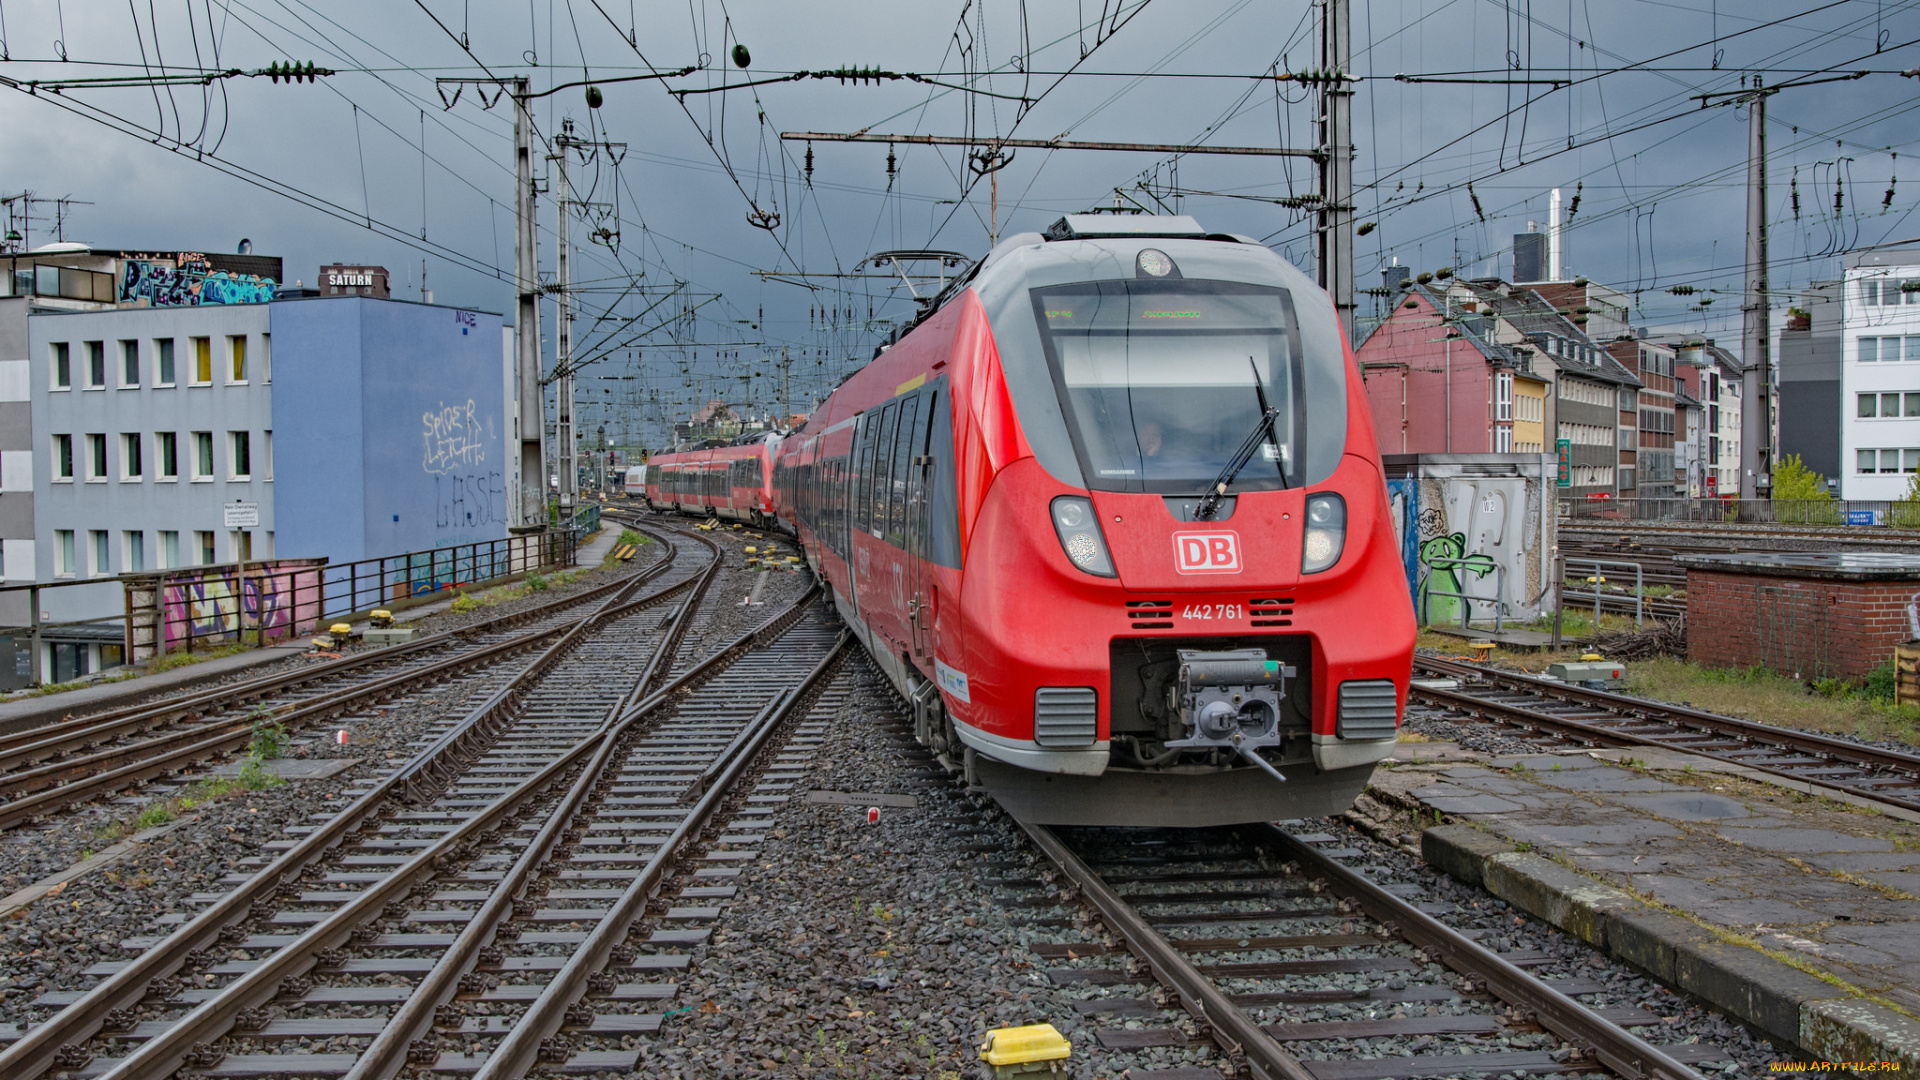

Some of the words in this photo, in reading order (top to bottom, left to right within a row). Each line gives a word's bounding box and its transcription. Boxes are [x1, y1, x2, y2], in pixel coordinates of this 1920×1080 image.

[329, 274, 373, 286] SATURN
[455, 310, 476, 327] NICE
[1181, 537, 1234, 567] DB
[1182, 604, 1212, 620] 442
[1215, 603, 1242, 620] 761
